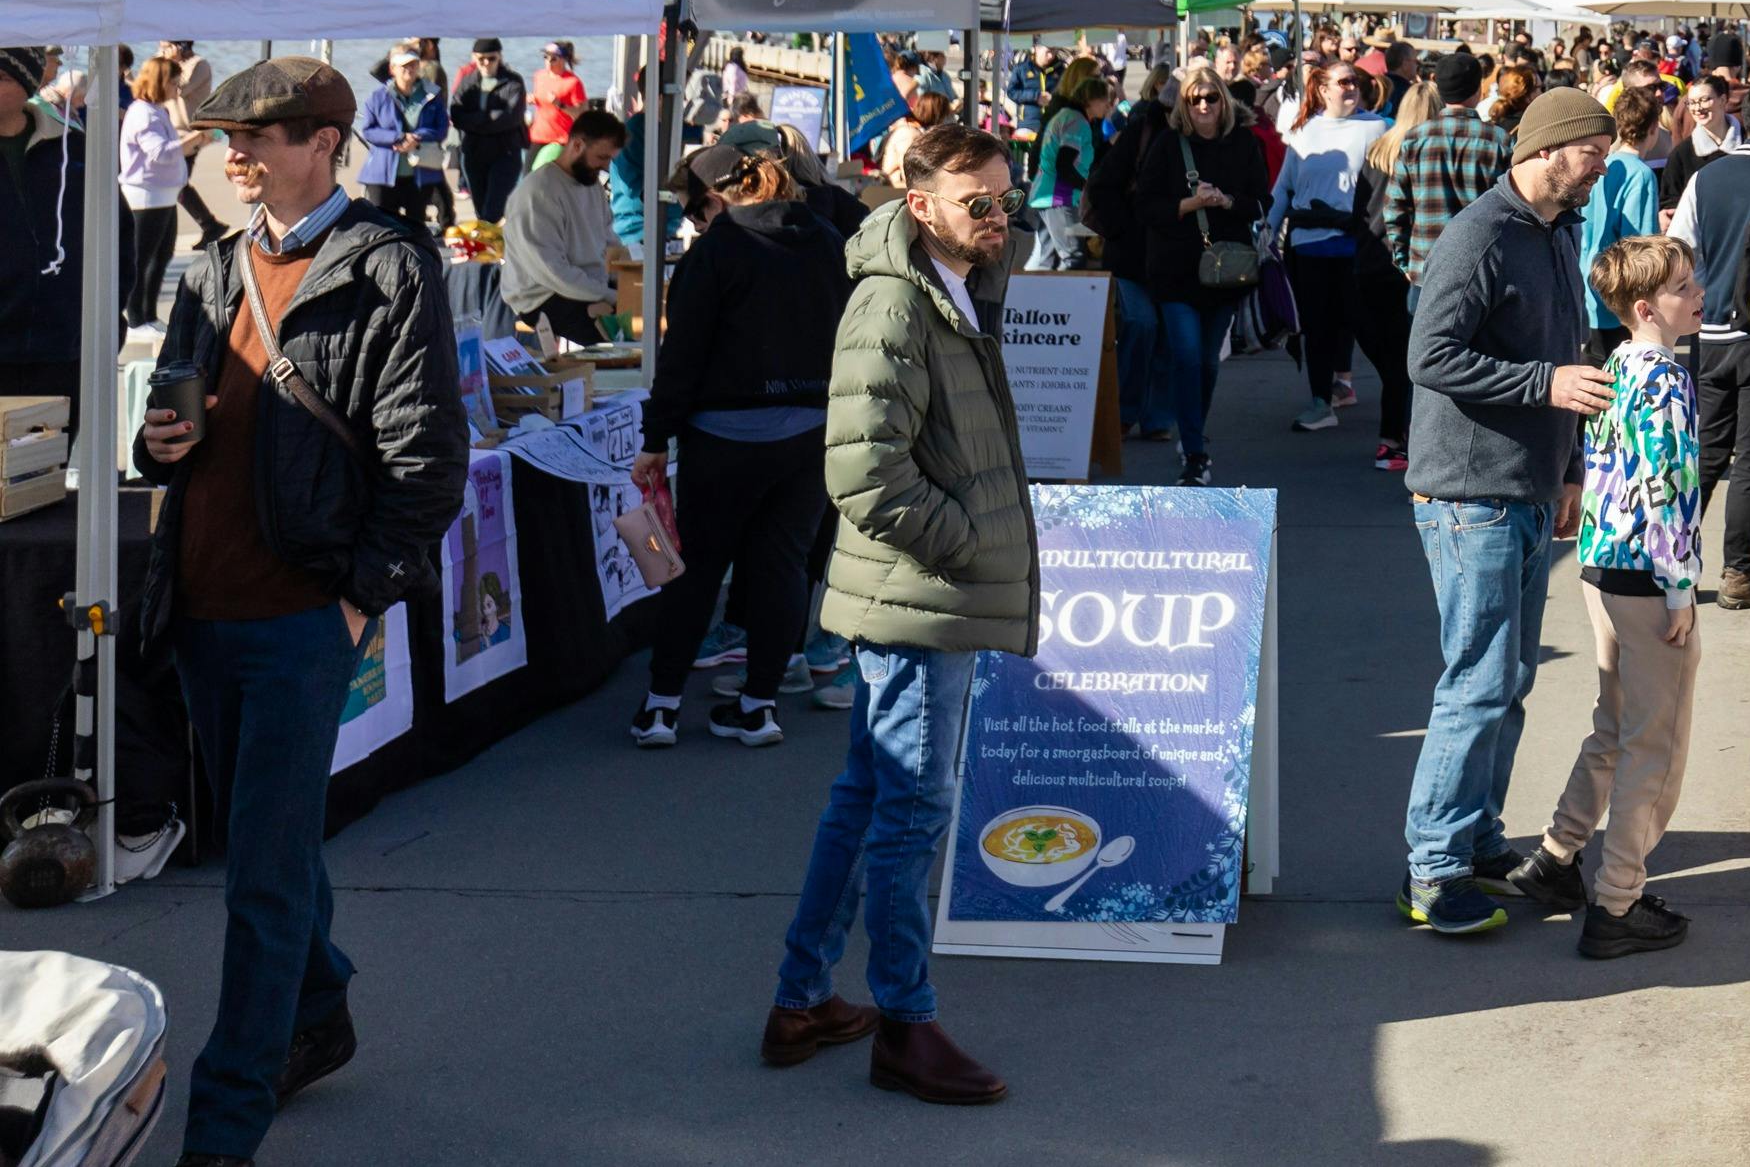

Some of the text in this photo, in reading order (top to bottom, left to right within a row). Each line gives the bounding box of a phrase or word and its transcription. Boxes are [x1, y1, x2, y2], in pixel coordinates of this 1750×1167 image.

[1003, 308, 1071, 325] Tallow
[1033, 671, 1209, 695] CELEBRATION
[984, 715, 1226, 735] Visit all the hot food stalls at the market
[980, 743, 1224, 764] today for a smorgasboard of unique and
[1012, 770, 1187, 791] delicious multicultural soups!
